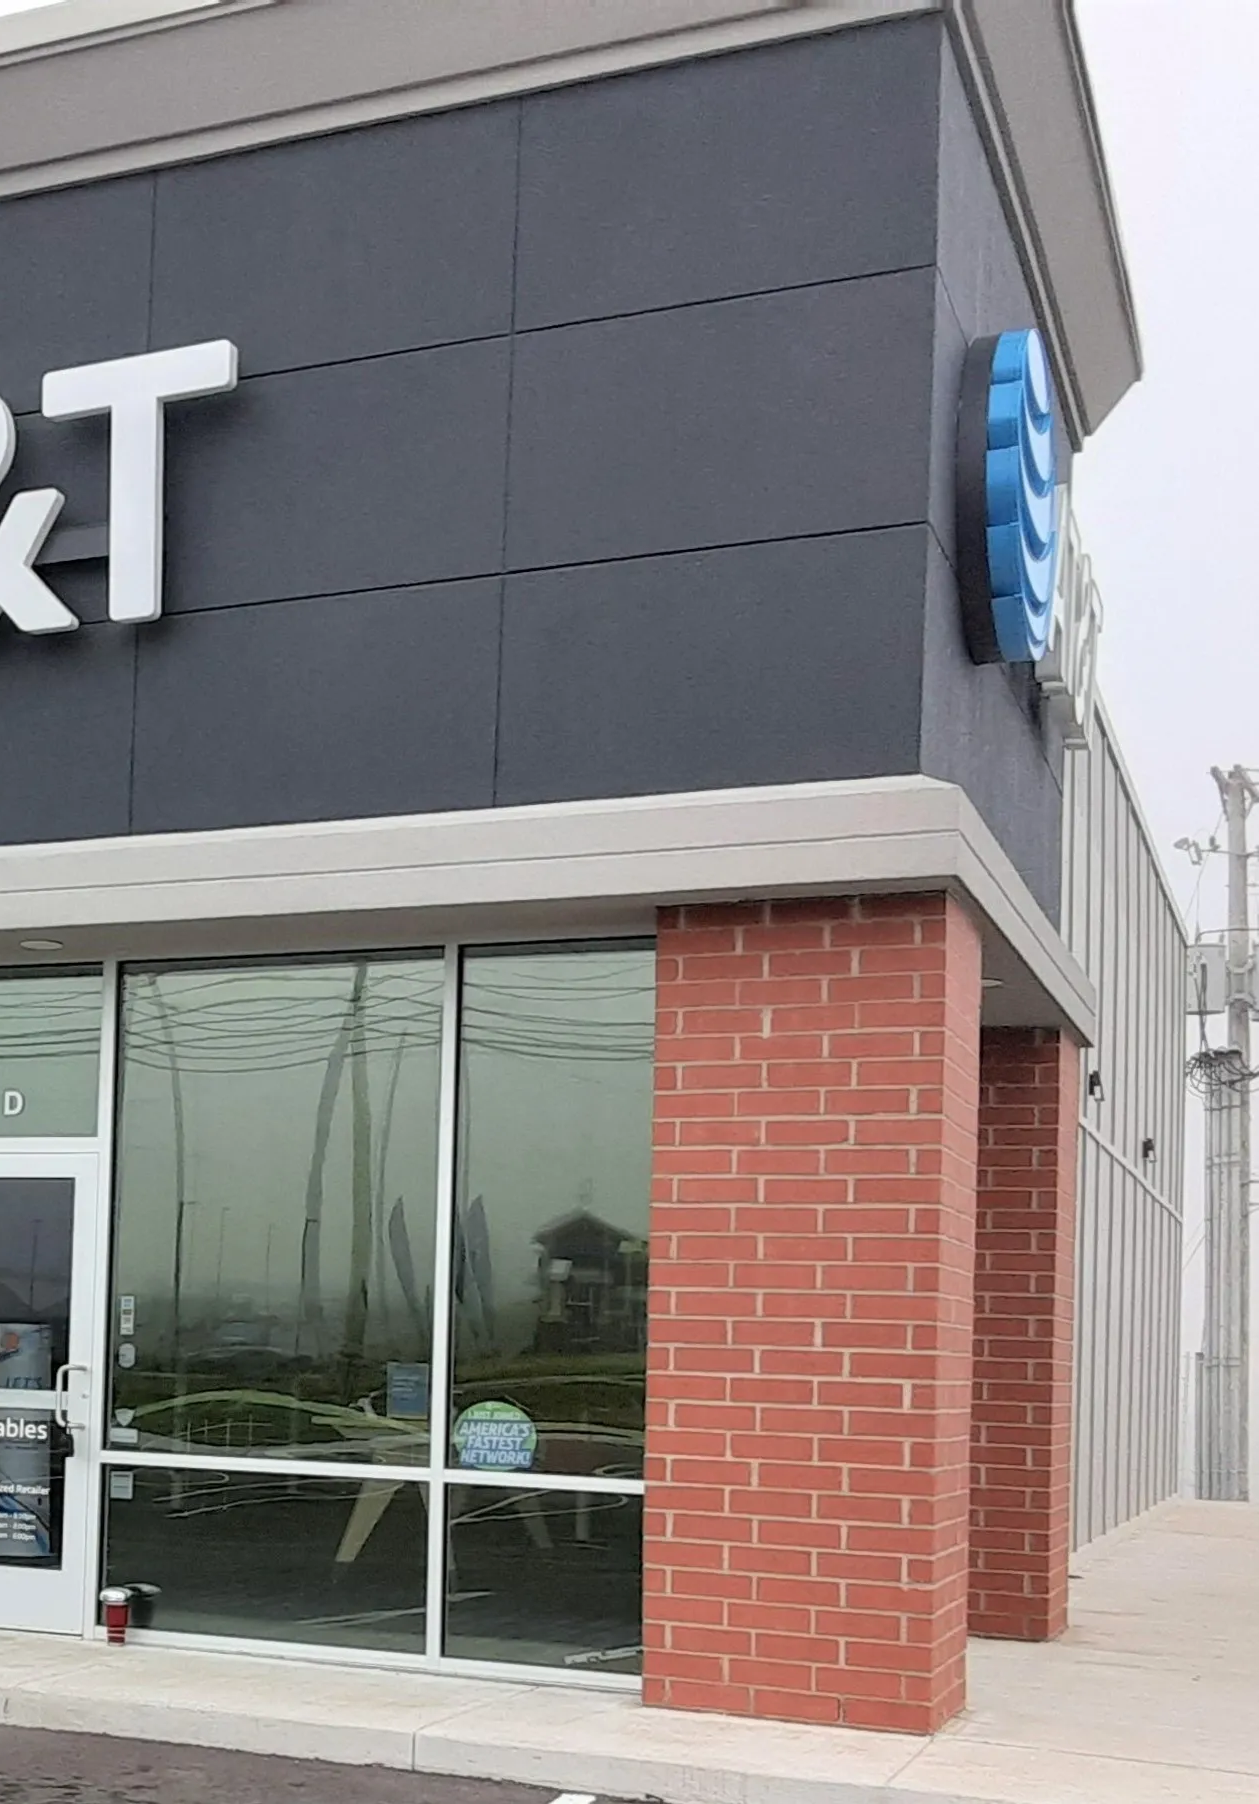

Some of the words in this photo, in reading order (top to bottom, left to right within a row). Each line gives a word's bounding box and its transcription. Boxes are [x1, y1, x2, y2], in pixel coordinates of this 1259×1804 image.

[3, 1091, 24, 1116] D
[459, 1421, 530, 1438] AMERICA'S
[466, 1436, 523, 1450] FASTEST
[460, 1448, 531, 1465] NETWORK!
[16, 1484, 50, 1495] Retailer
